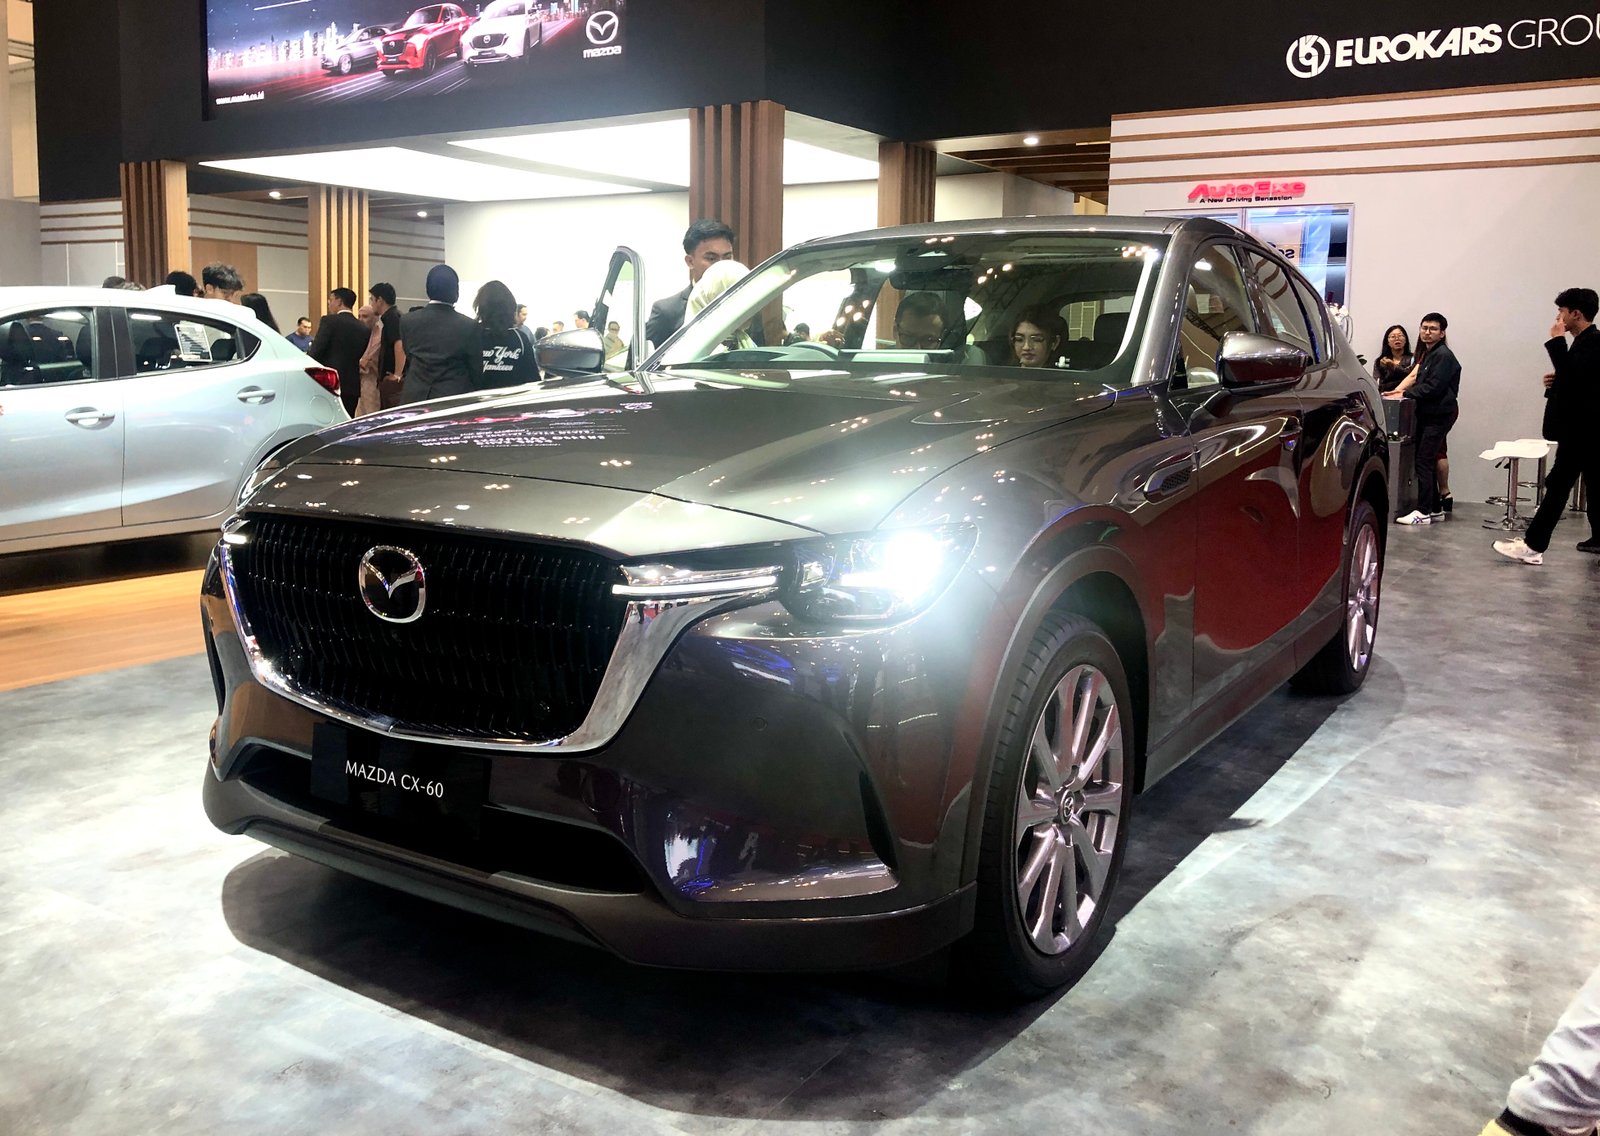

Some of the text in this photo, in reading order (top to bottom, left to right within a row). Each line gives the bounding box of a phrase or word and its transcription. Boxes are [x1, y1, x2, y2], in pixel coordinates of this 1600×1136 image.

[1335, 14, 1600, 68] EUROKARS GRO
[494, 346, 521, 363] York
[345, 760, 444, 798] MAZDA CX-60
